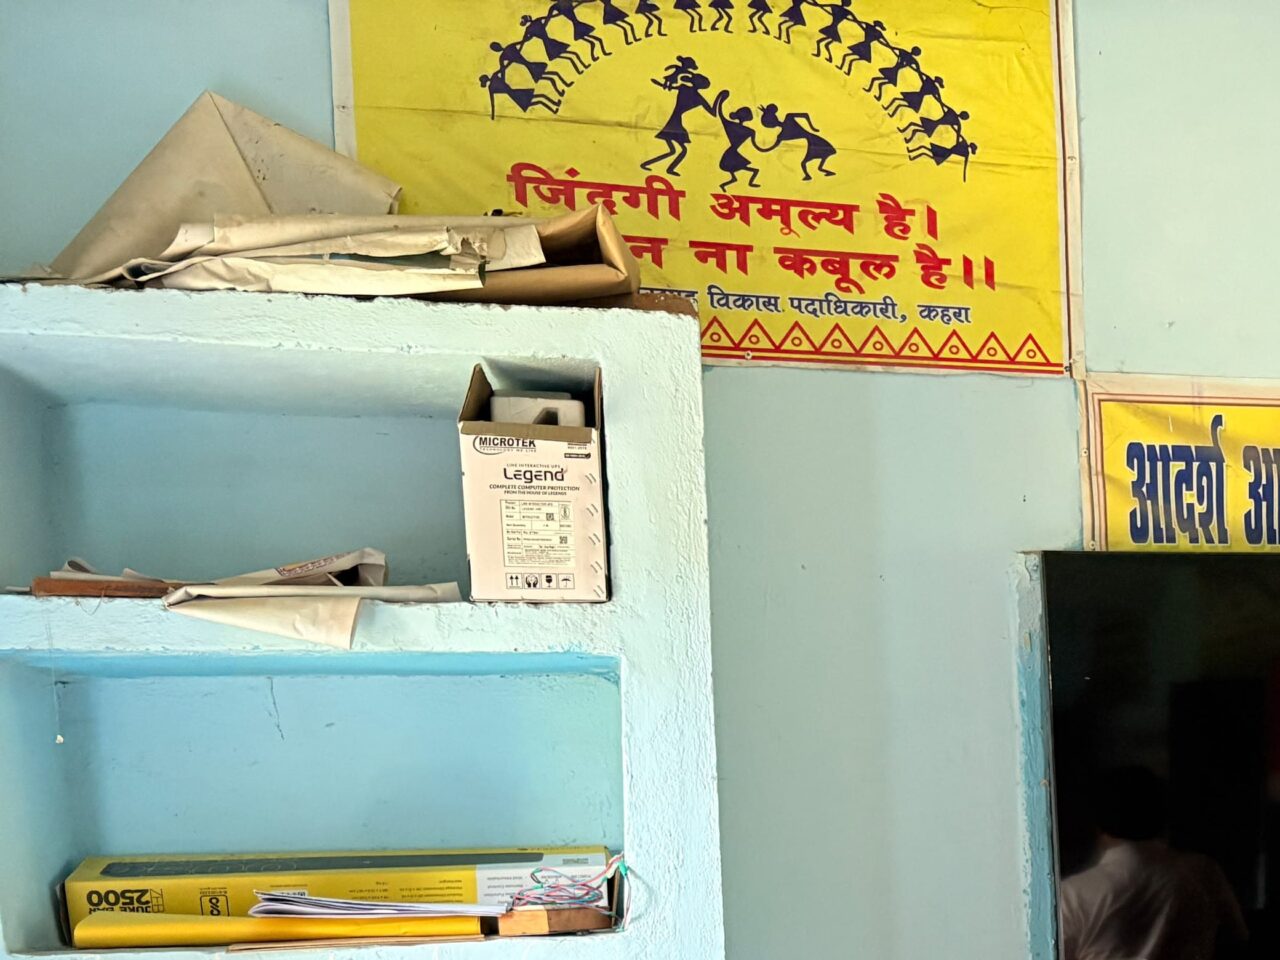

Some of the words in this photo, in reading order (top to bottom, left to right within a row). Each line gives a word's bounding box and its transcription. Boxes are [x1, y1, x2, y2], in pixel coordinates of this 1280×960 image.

[507, 162, 686, 221] जिंदगी
[710, 192, 860, 238] अमूल्य
[689, 240, 754, 275] ना
[774, 246, 898, 294] कबूल
[707, 285, 781, 313] विकास
[788, 291, 908, 324] पदाधिकारी,
[917, 303, 972, 325] कहरा
[479, 437, 536, 447] MICROTEK
[1126, 414, 1229, 545] आदर्श
[86, 889, 150, 908] 2500
